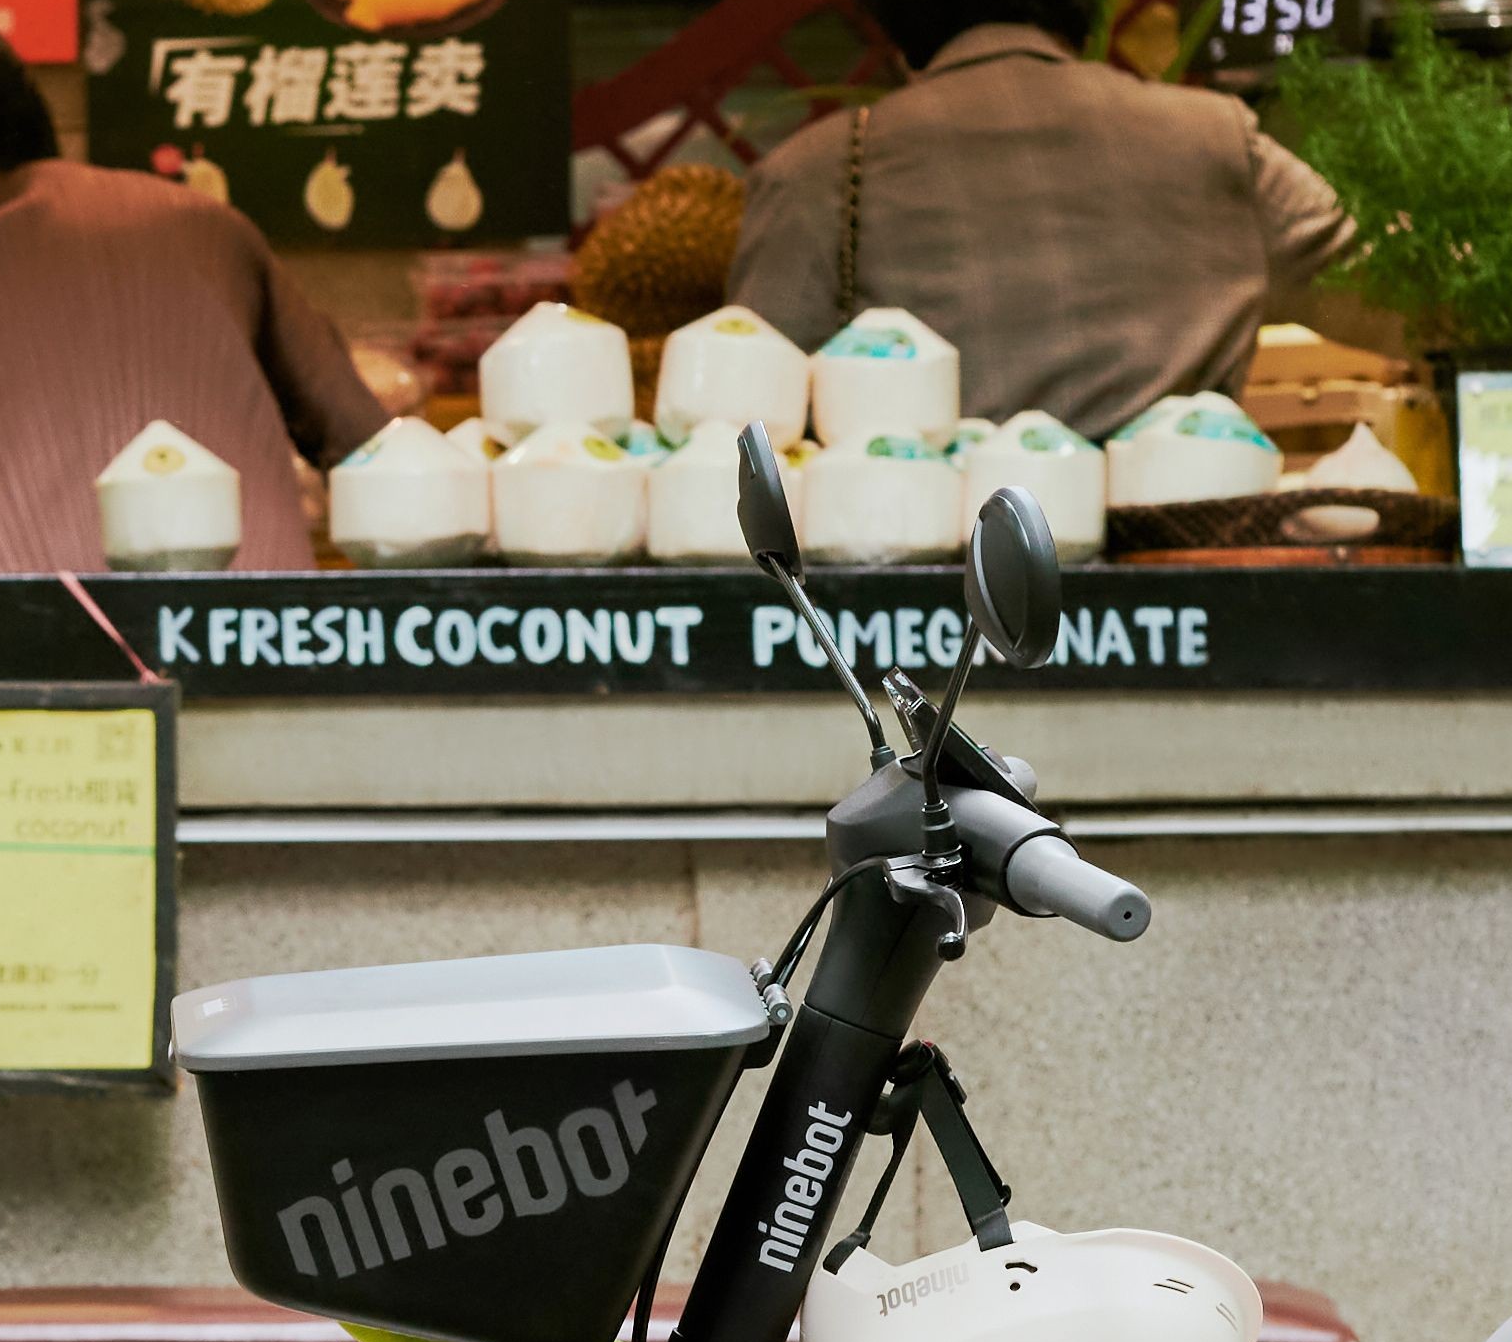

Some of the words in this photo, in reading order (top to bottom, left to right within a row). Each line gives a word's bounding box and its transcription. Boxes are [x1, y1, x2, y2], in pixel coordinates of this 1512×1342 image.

[207, 606, 385, 666] FRESH
[394, 605, 704, 666] COCONUT
[751, 604, 1210, 668] POMEGNATE
[276, 1078, 659, 1279] ninebot
[757, 1100, 853, 1274] ninebot
[876, 1261, 970, 1317] ninebot
